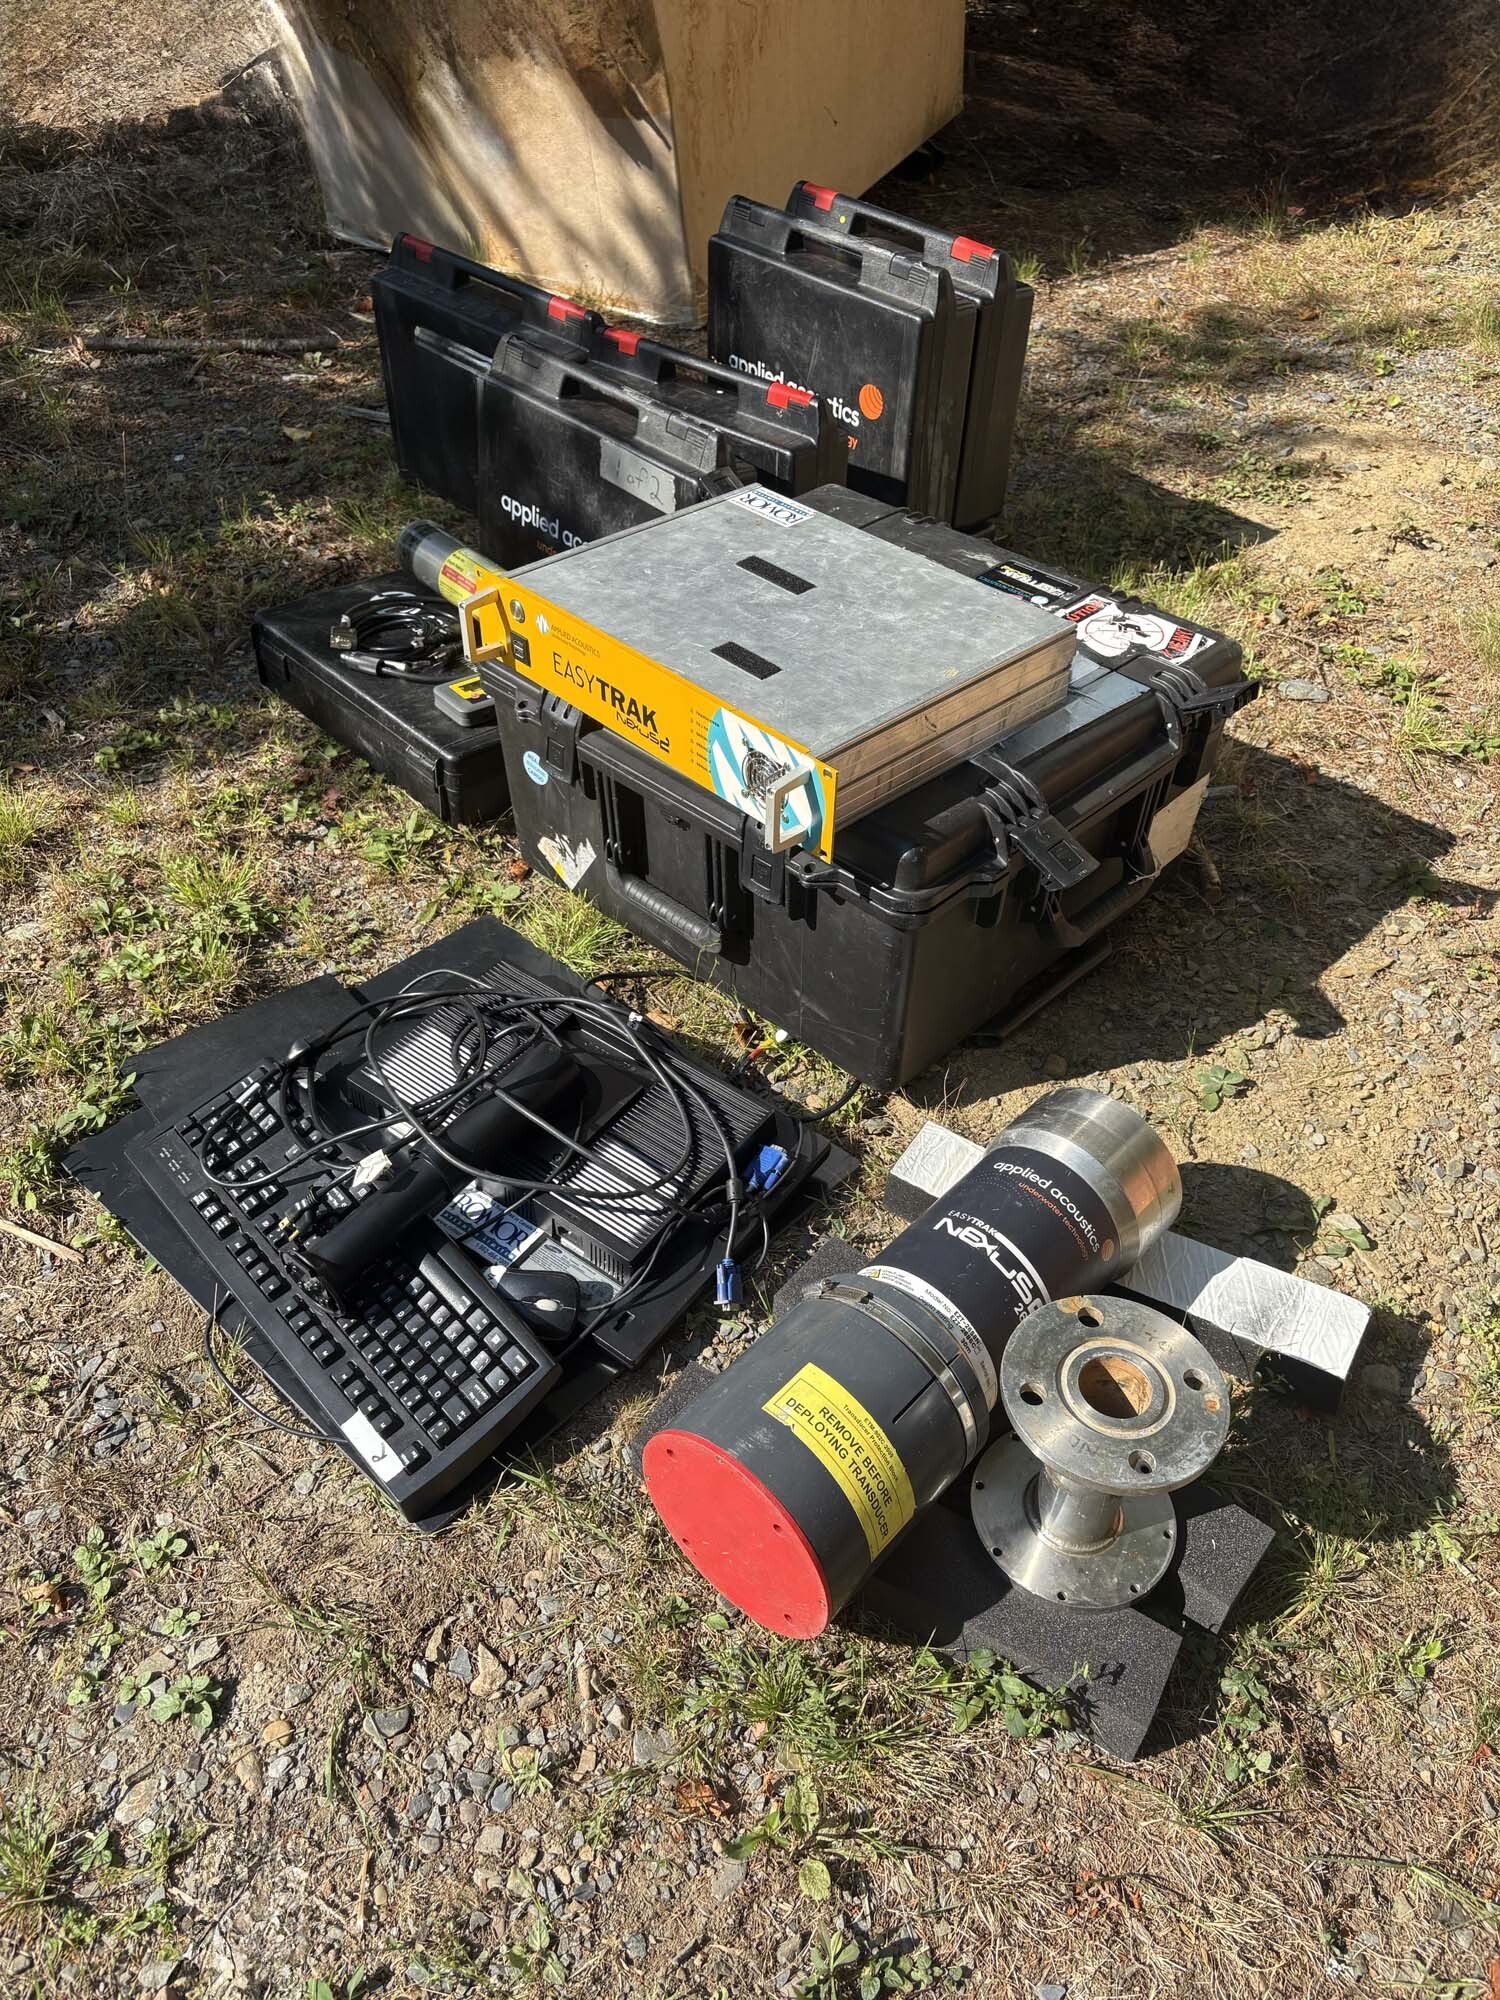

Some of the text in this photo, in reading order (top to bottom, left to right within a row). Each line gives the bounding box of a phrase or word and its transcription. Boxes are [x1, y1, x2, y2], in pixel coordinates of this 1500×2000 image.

[627, 466, 649, 488] of
[650, 475, 664, 505] 2
[501, 494, 560, 540] applied
[552, 651, 658, 733] EASYTRAK
[451, 1193, 529, 1252] ROMOR
[948, 1209, 999, 1237] EASYTRAK
[993, 1161, 1100, 1253] applied acoustics
[1018, 1182, 1089, 1261] underwater technology
[925, 1288, 943, 1304] Model
[818, 1406, 893, 1508] REMOVE BEFORE
[843, 1404, 870, 1435] Transducer
[869, 1434, 890, 1466] Protection
[785, 1397, 889, 1537] DEPLOYING TRANSDUCER
